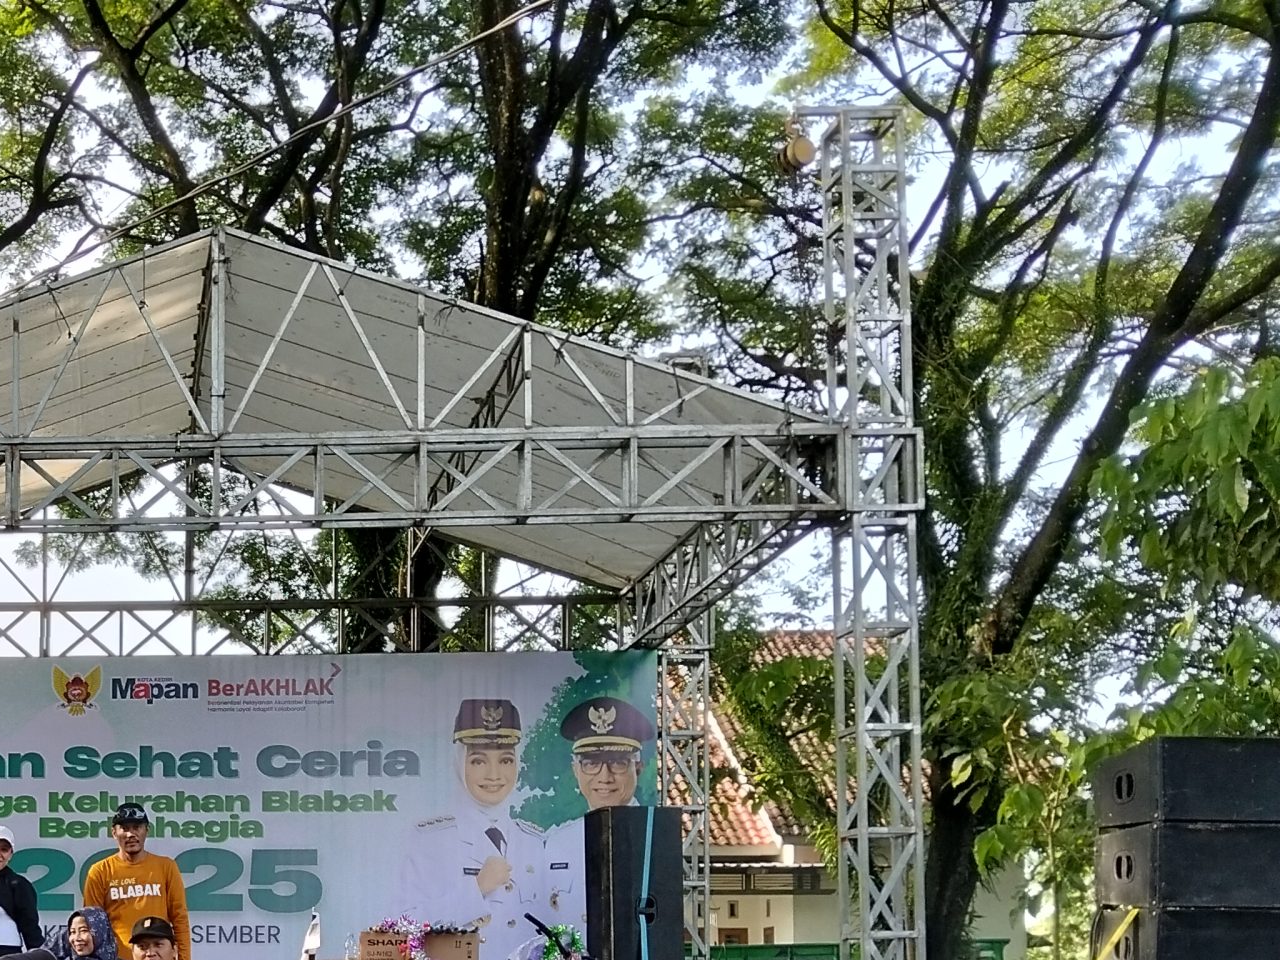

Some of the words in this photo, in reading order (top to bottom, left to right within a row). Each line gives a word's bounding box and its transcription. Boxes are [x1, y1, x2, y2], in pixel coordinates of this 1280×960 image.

[112, 678, 199, 704] Mapan
[207, 678, 335, 697] BerAKHLAK
[63, 745, 239, 779] Sehat
[256, 740, 420, 778] Ceria
[261, 789, 398, 813] Blabak
[109, 883, 161, 900] BLABAK
[121, 877, 136, 886] LOVE
